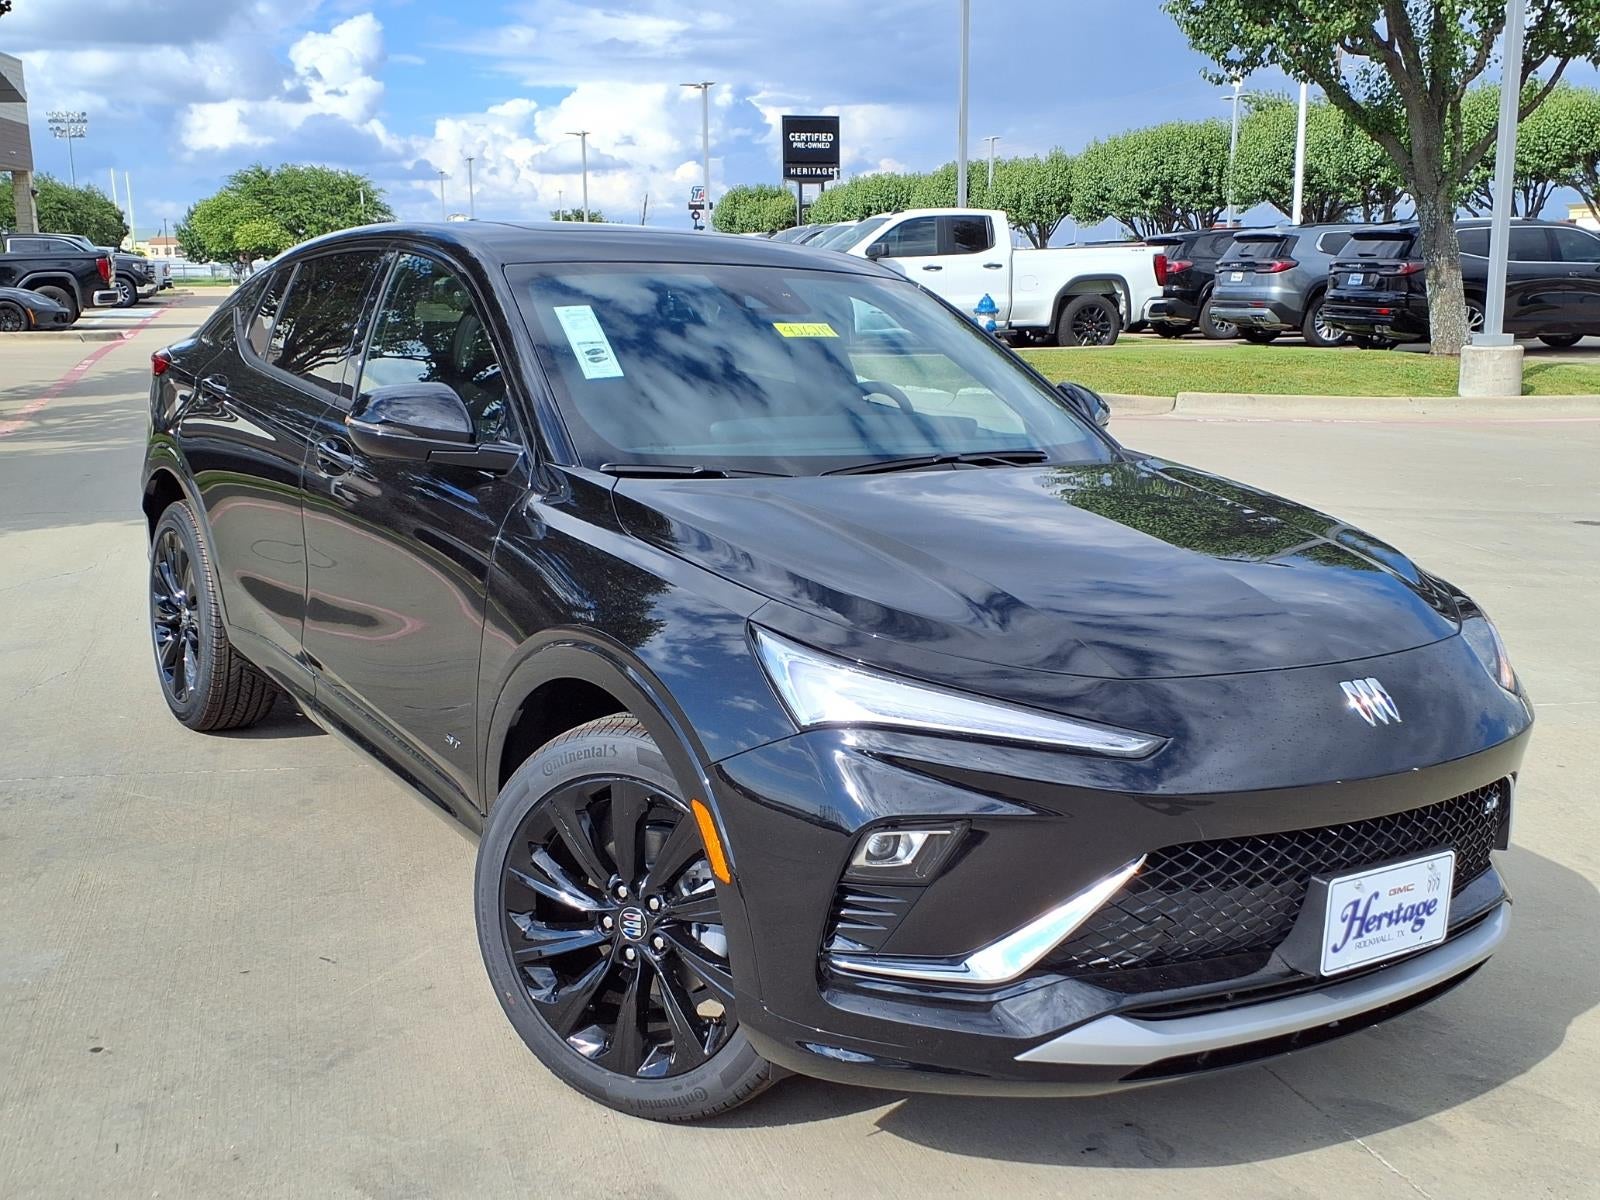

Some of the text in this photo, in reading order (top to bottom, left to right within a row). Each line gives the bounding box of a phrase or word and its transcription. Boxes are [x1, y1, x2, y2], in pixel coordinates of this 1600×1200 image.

[789, 132, 834, 142] CERTIFIED
[790, 167, 834, 176] HERITAGE
[542, 743, 607, 777] Continental
[1388, 883, 1416, 897] GMC
[1331, 890, 1439, 954] Heritage
